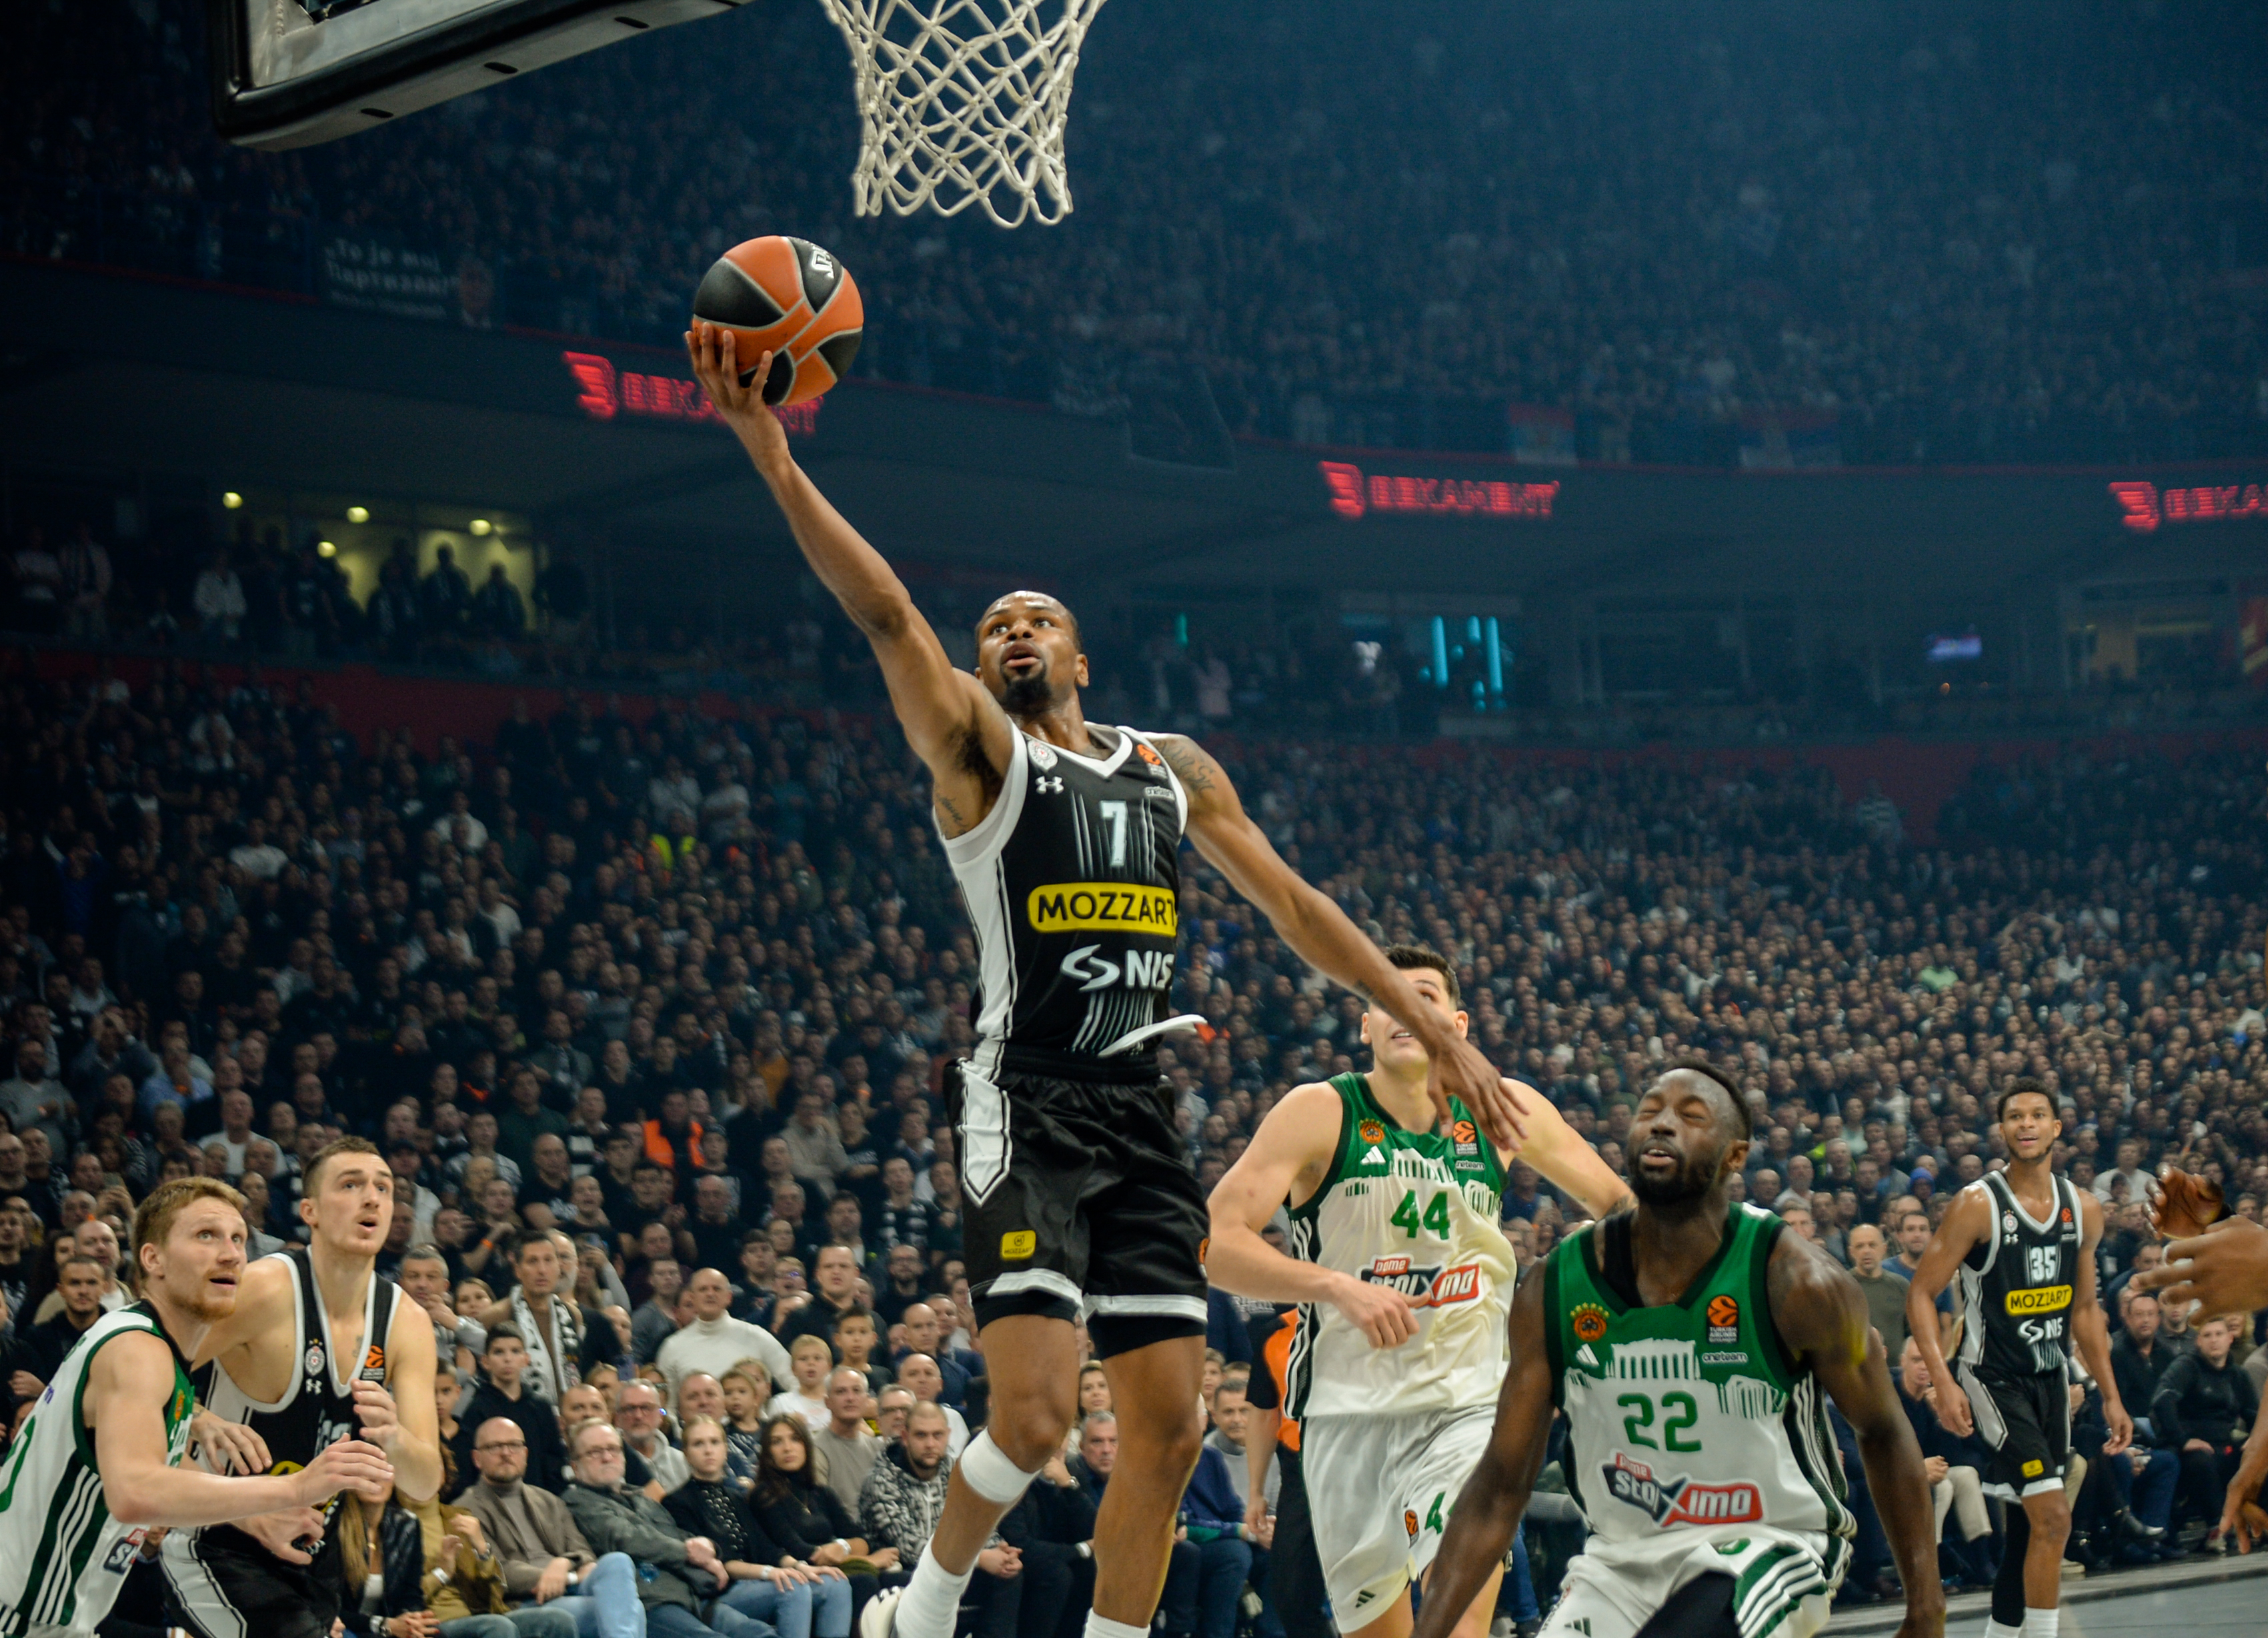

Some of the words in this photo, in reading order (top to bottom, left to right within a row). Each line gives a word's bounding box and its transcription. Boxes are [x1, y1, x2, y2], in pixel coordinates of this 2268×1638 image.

[1100, 800, 1126, 867] 7
[1037, 891, 1175, 926] MOZZART
[1125, 950, 1175, 990] NIS
[1390, 1189, 1450, 1240] 44
[2031, 1246, 2056, 1281] 35
[2011, 1290, 2068, 1310] MOZZART
[2045, 1317, 2063, 1339] NIS
[1703, 1352, 1748, 1362] oneteam
[1617, 1390, 1702, 1452] 22
